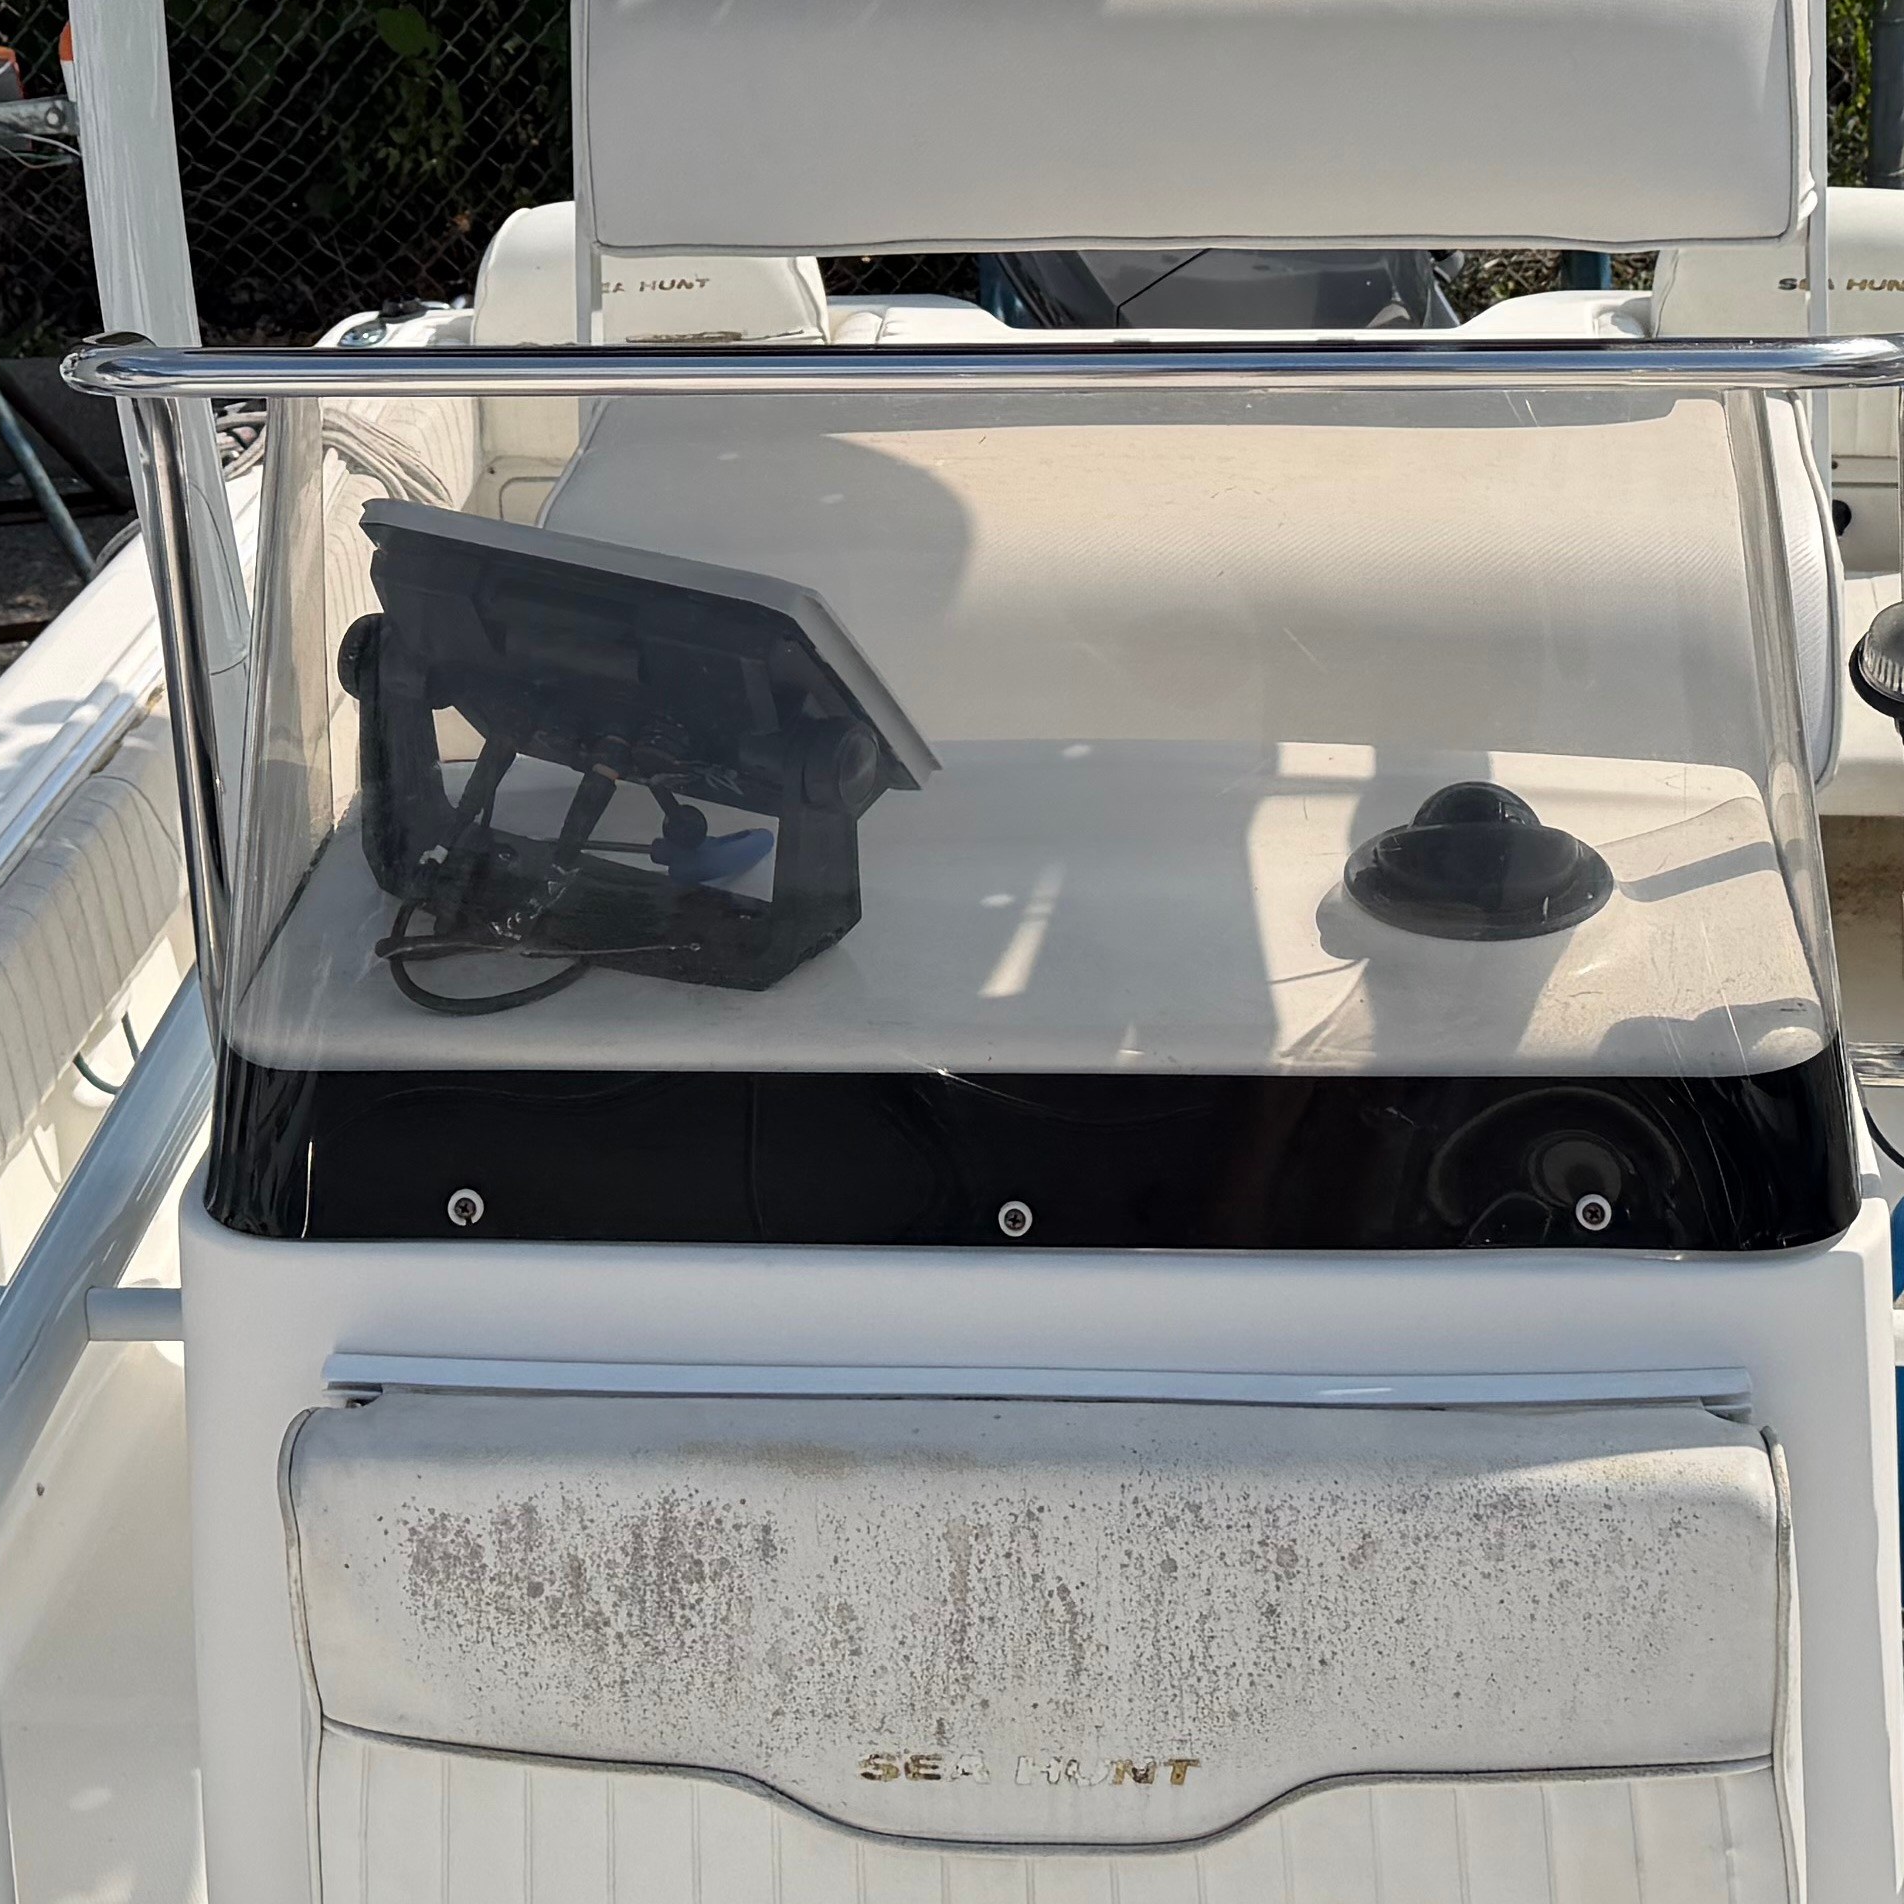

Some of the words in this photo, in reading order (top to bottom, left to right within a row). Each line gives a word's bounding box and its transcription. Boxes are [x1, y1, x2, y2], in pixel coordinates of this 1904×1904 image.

[639, 278, 710, 292] HUNT
[858, 1753, 992, 1784] SEA
[1014, 1755, 1200, 1786] HUNT
